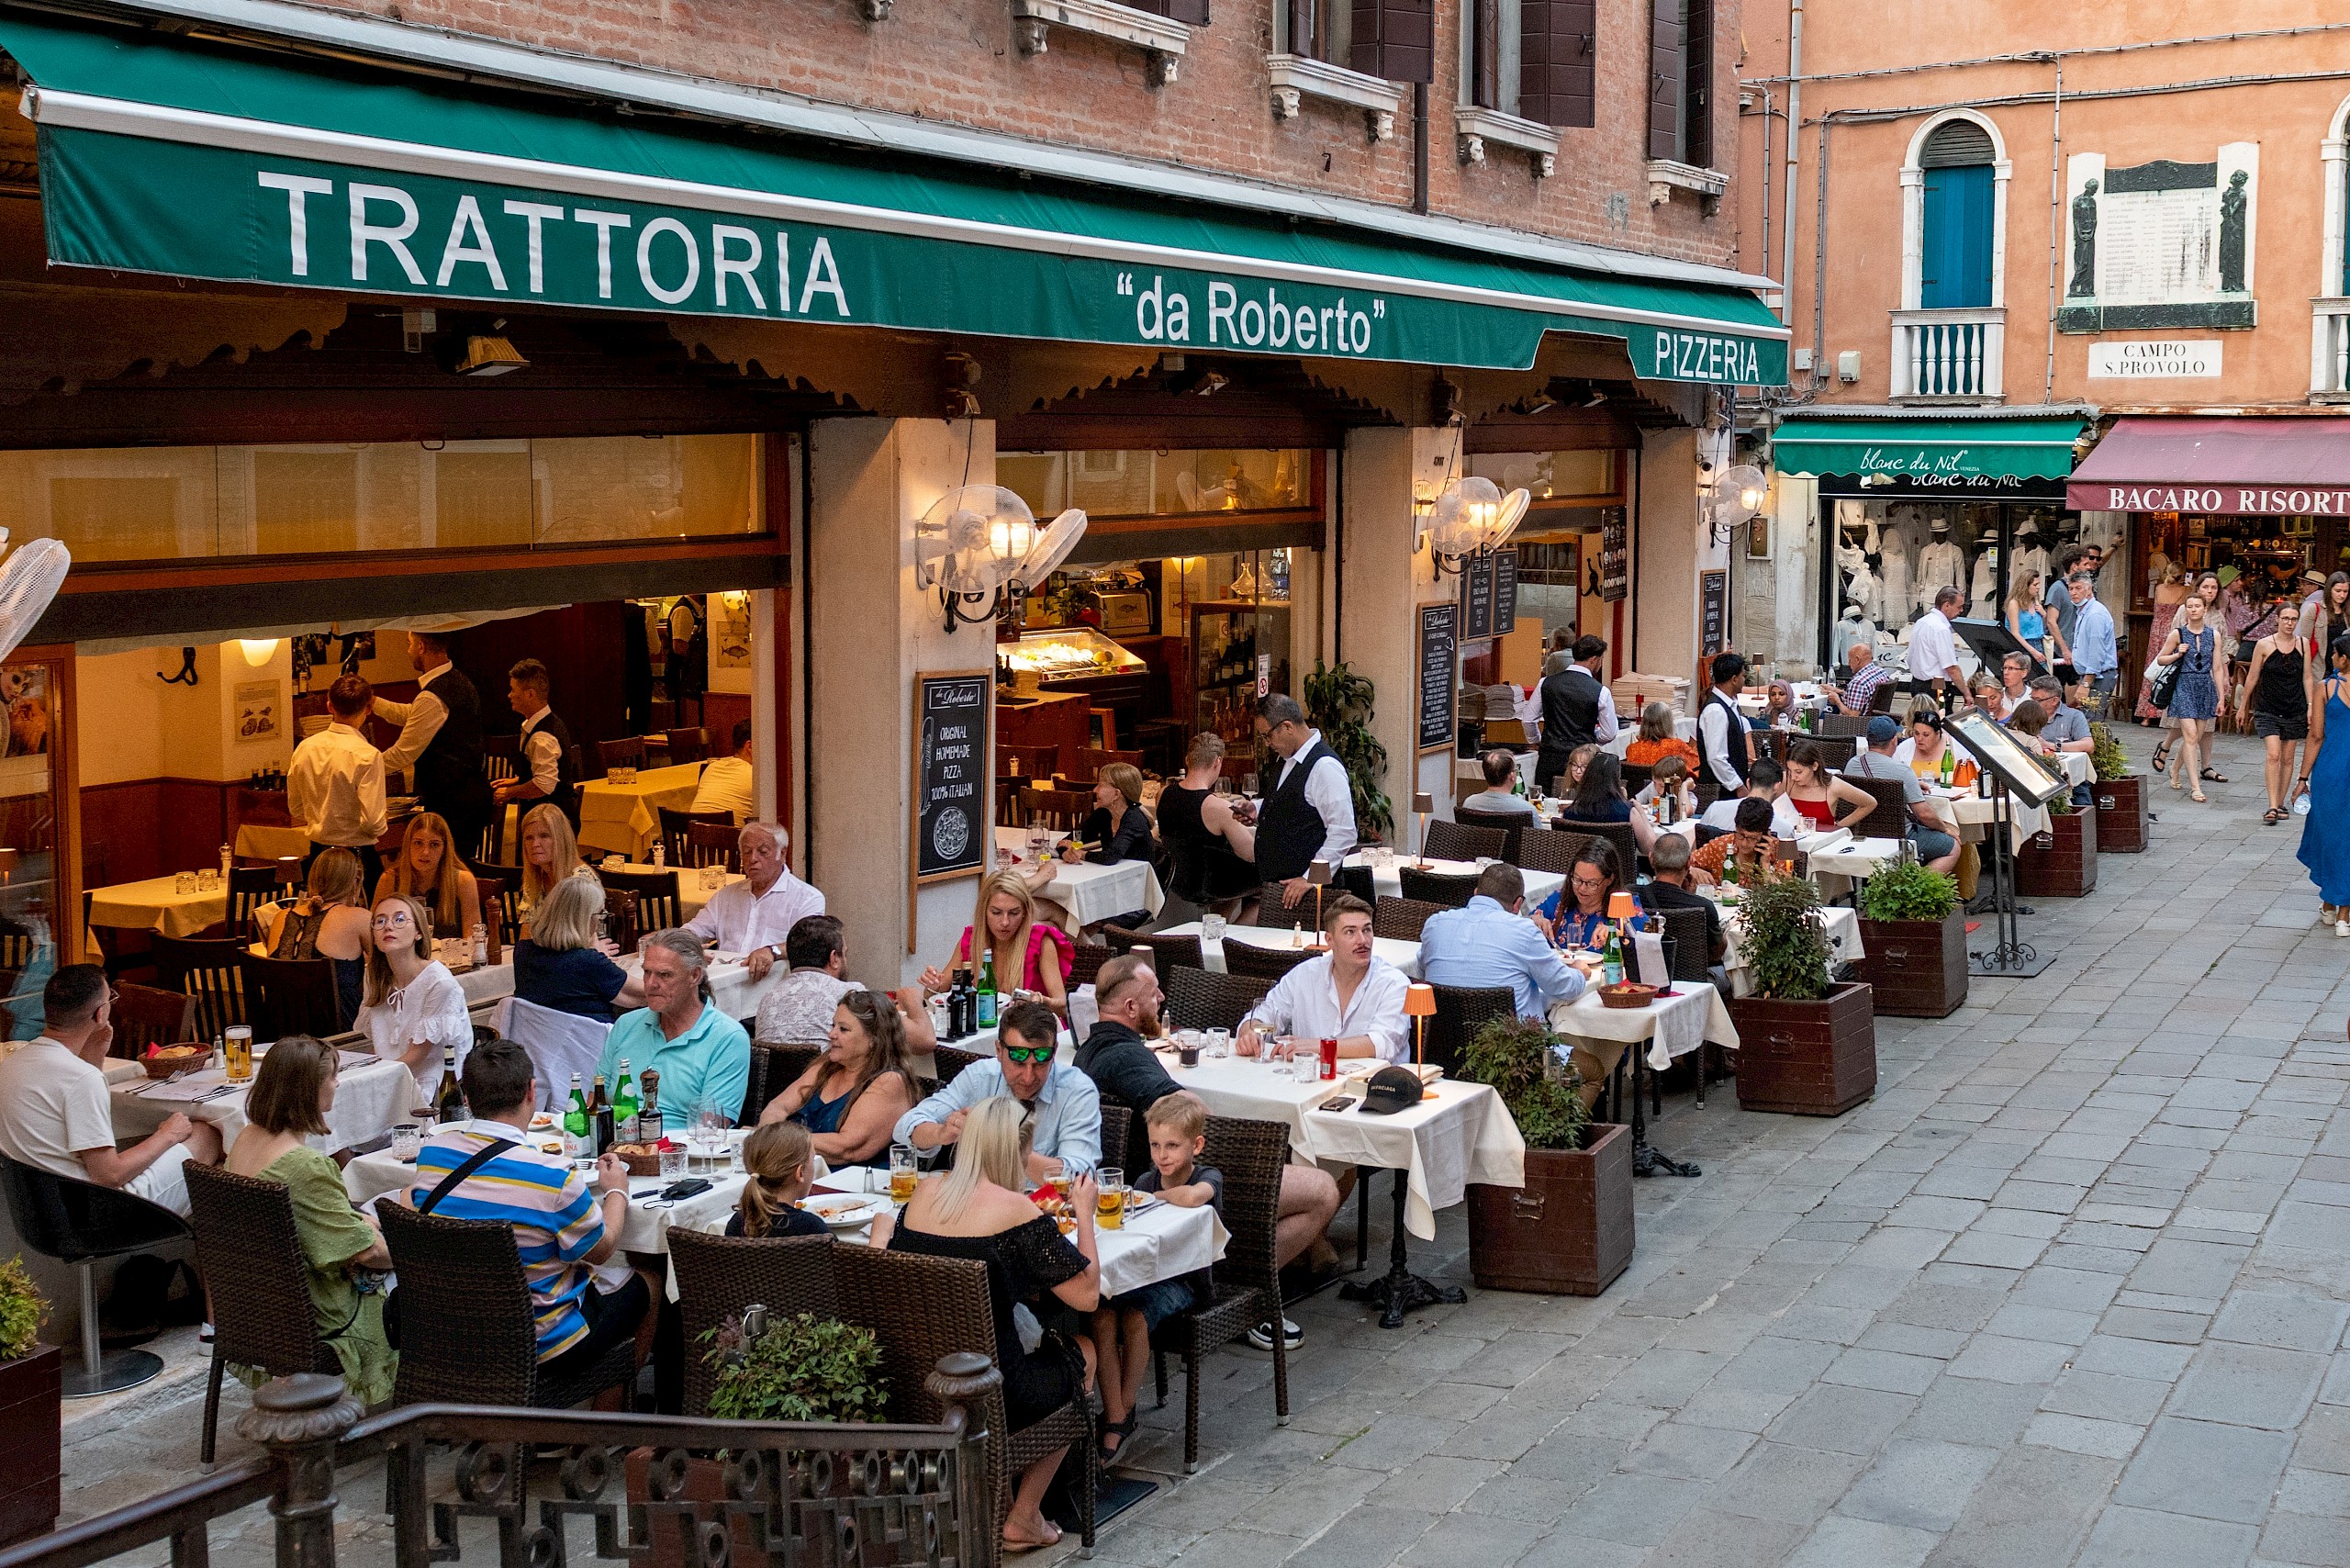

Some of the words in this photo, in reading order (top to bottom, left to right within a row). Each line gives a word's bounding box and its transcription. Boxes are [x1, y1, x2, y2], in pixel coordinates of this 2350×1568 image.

[258, 171, 851, 317] TRATTORIA
[1655, 331, 1760, 382] PIZZERIA
[2123, 343, 2187, 358] CAMPO
[1860, 447, 1906, 470] blanc
[1909, 451, 1930, 470] du
[2108, 487, 2222, 511] BACARO
[2237, 489, 2350, 514] RISORT
[941, 688, 977, 705] Roberto
[935, 744, 971, 761] HOMEMADE
[943, 764, 962, 779] PIZZA
[931, 785, 948, 801] 100%
